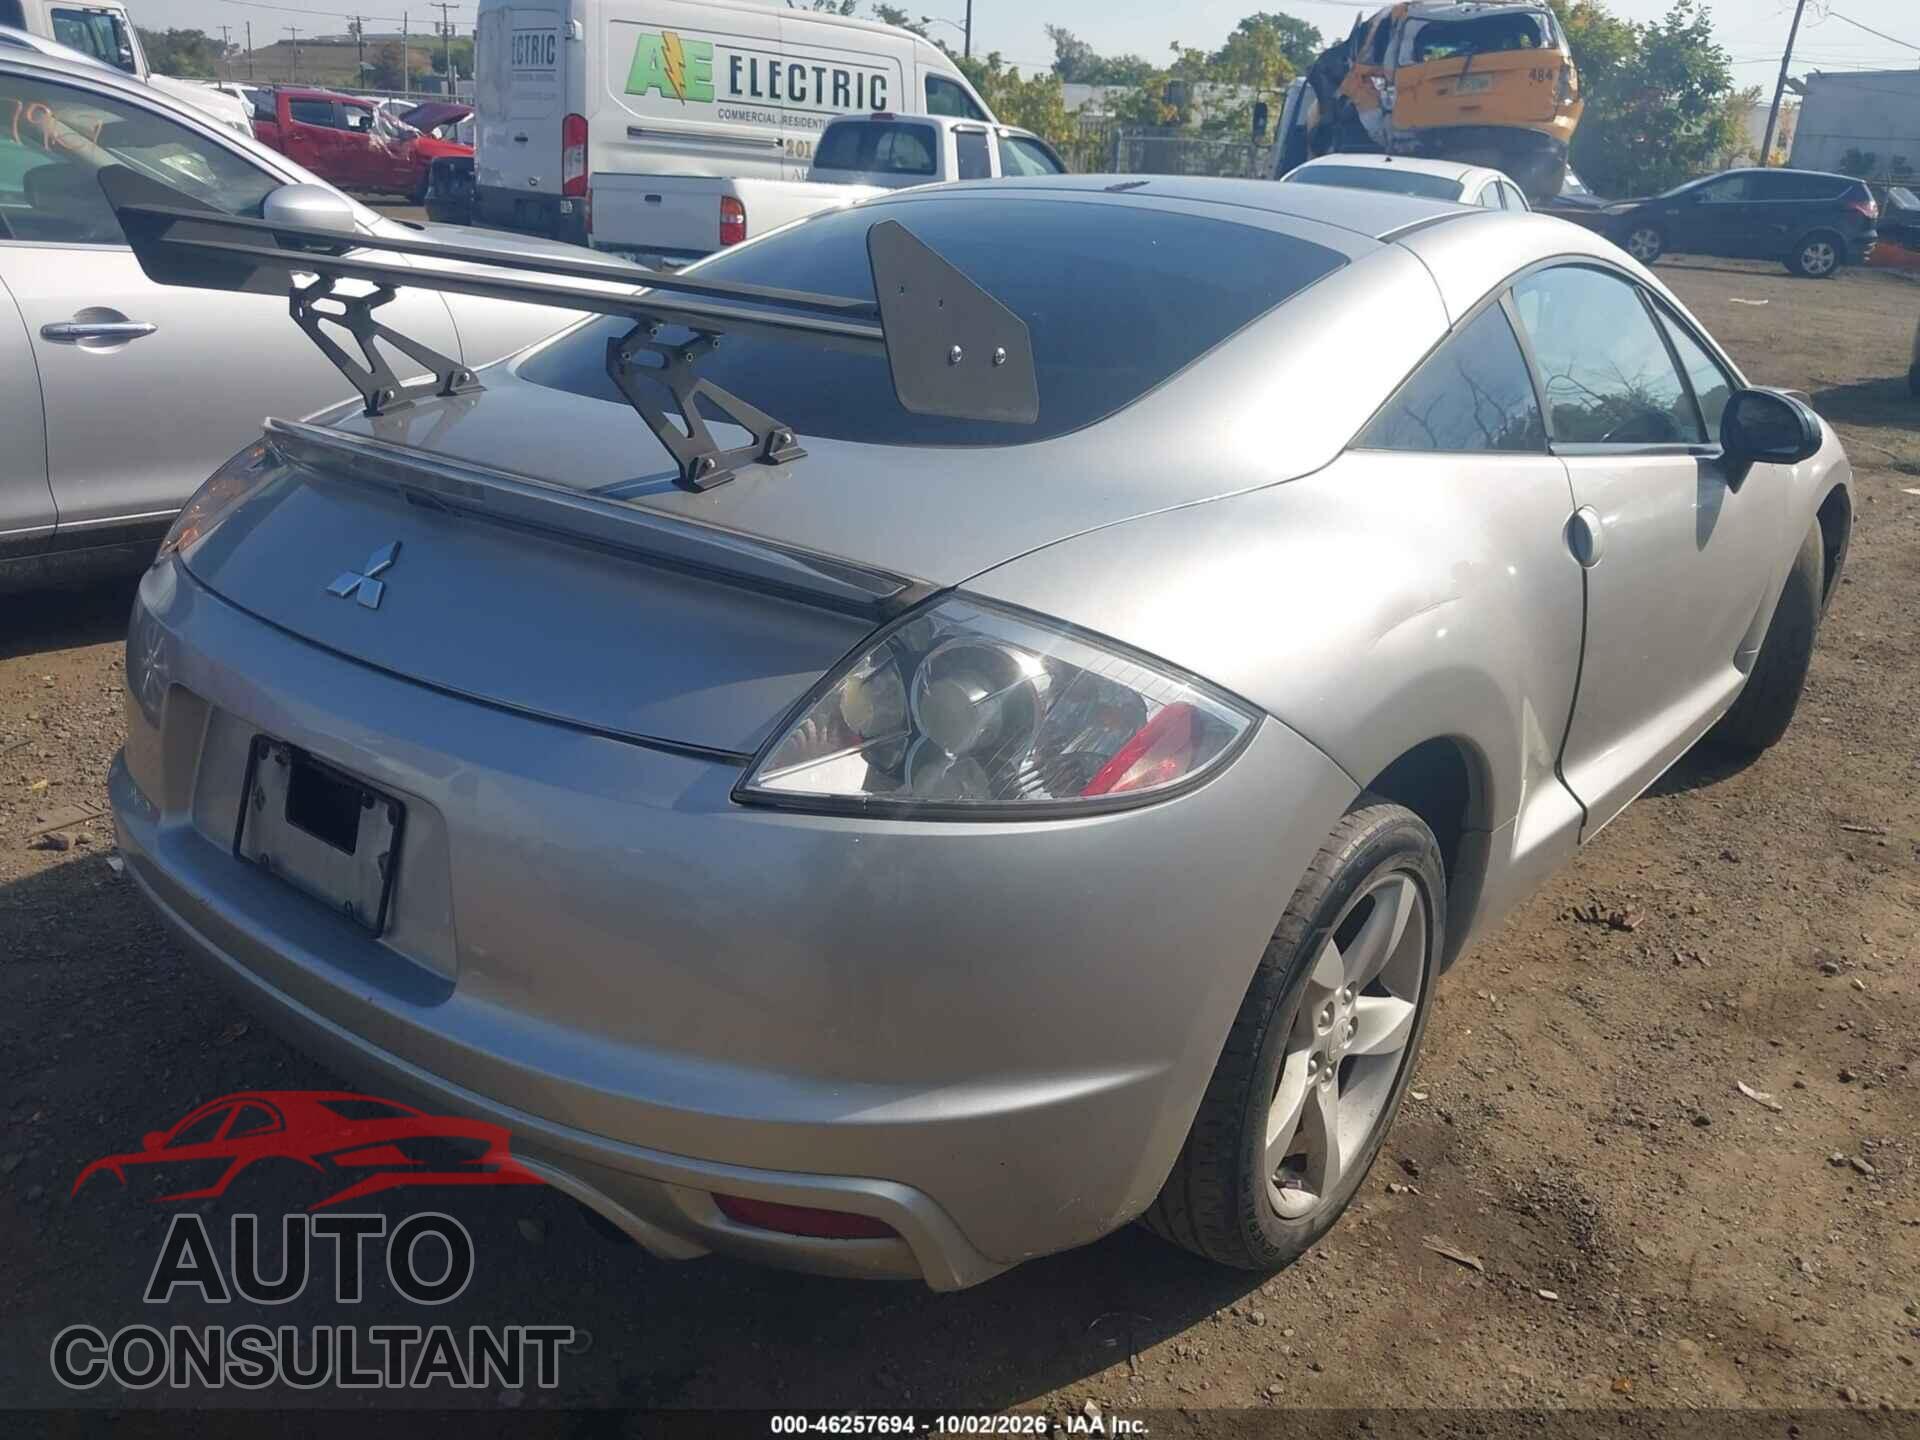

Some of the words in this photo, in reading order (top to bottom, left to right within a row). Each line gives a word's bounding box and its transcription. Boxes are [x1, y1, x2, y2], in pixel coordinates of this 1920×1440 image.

[624, 32, 715, 103] AE
[729, 54, 888, 112] ELECTRIC
[718, 108, 777, 125] COMMERCIAL
